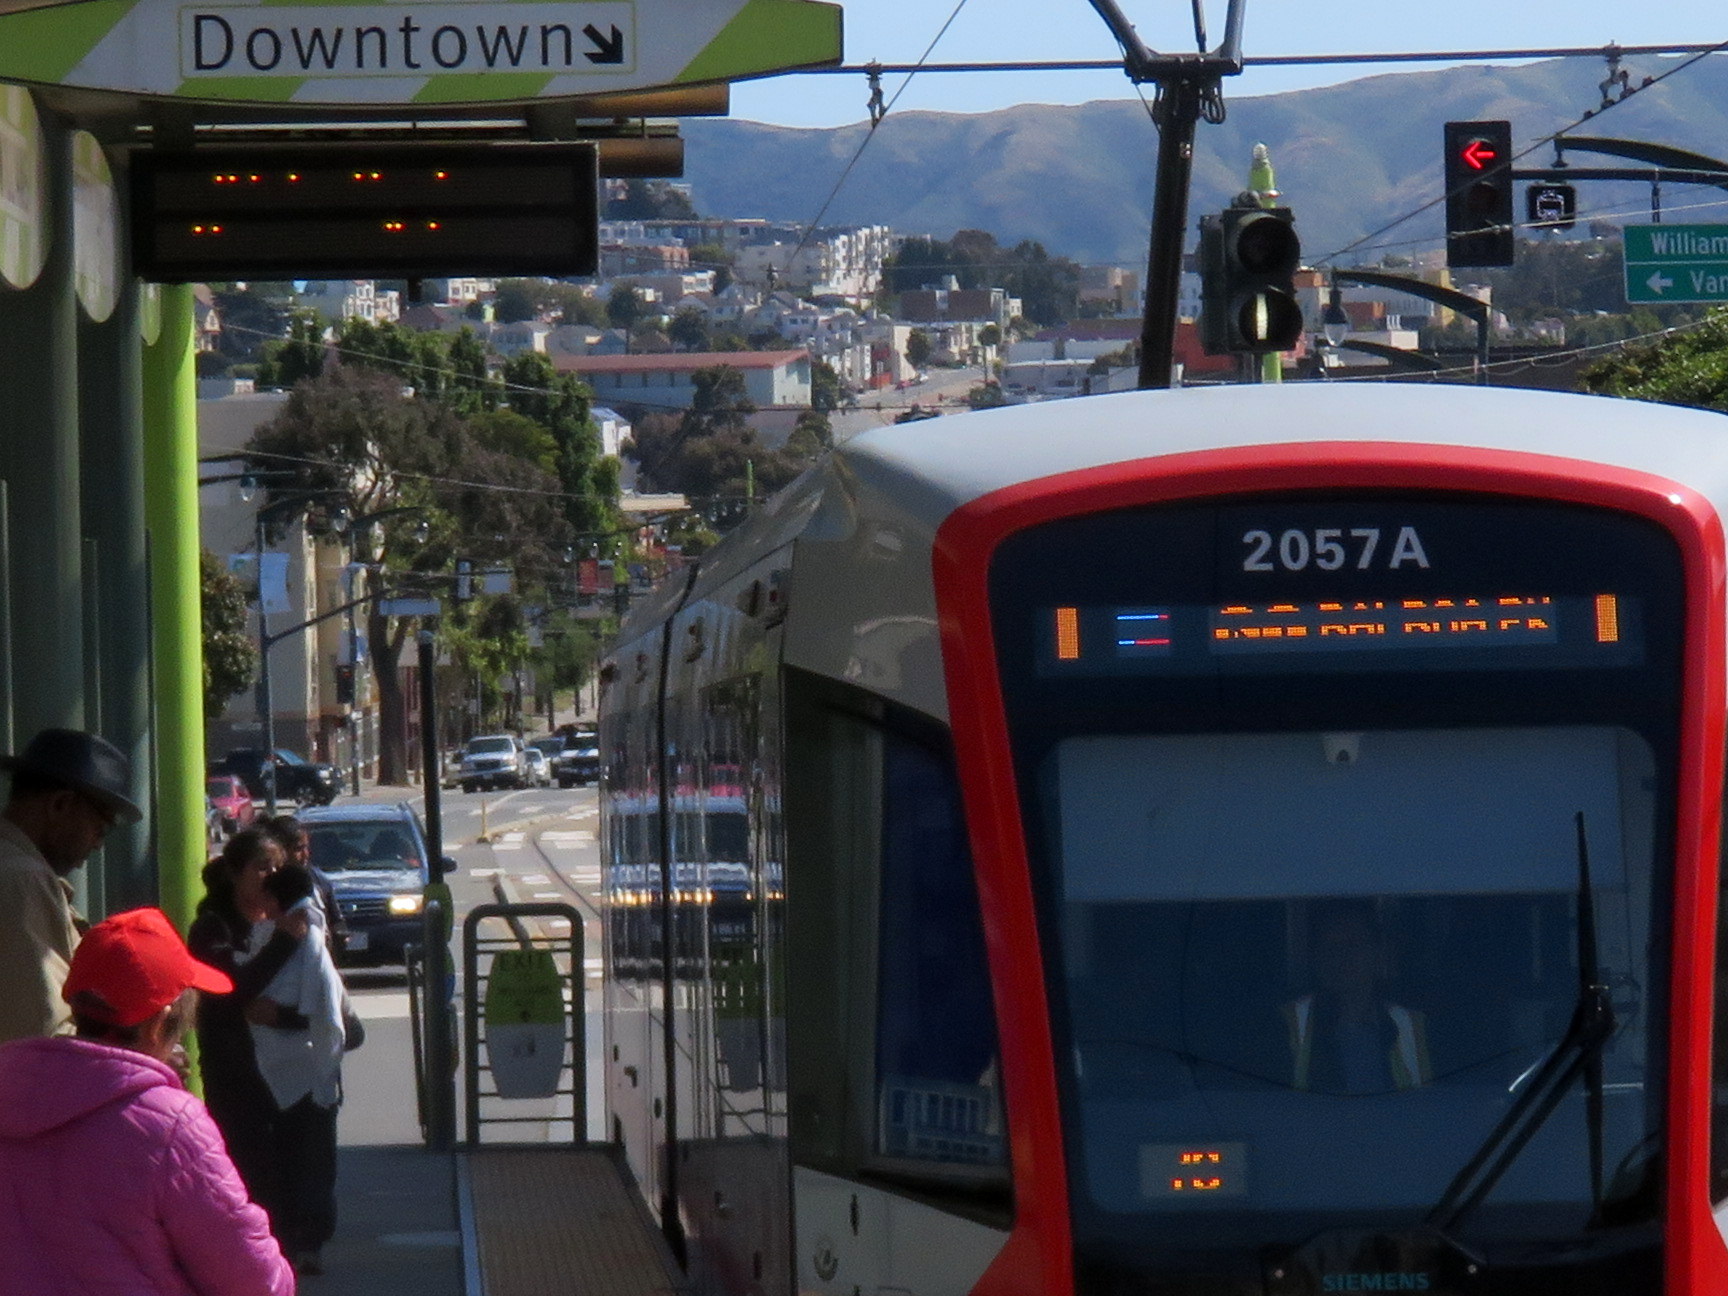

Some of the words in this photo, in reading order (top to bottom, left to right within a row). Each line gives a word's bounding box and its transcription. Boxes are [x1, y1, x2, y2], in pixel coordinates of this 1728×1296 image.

[193, 12, 573, 71] Downtown
[1241, 525, 1431, 572] 2057A
[1322, 1272, 1430, 1292] SIEMENS
